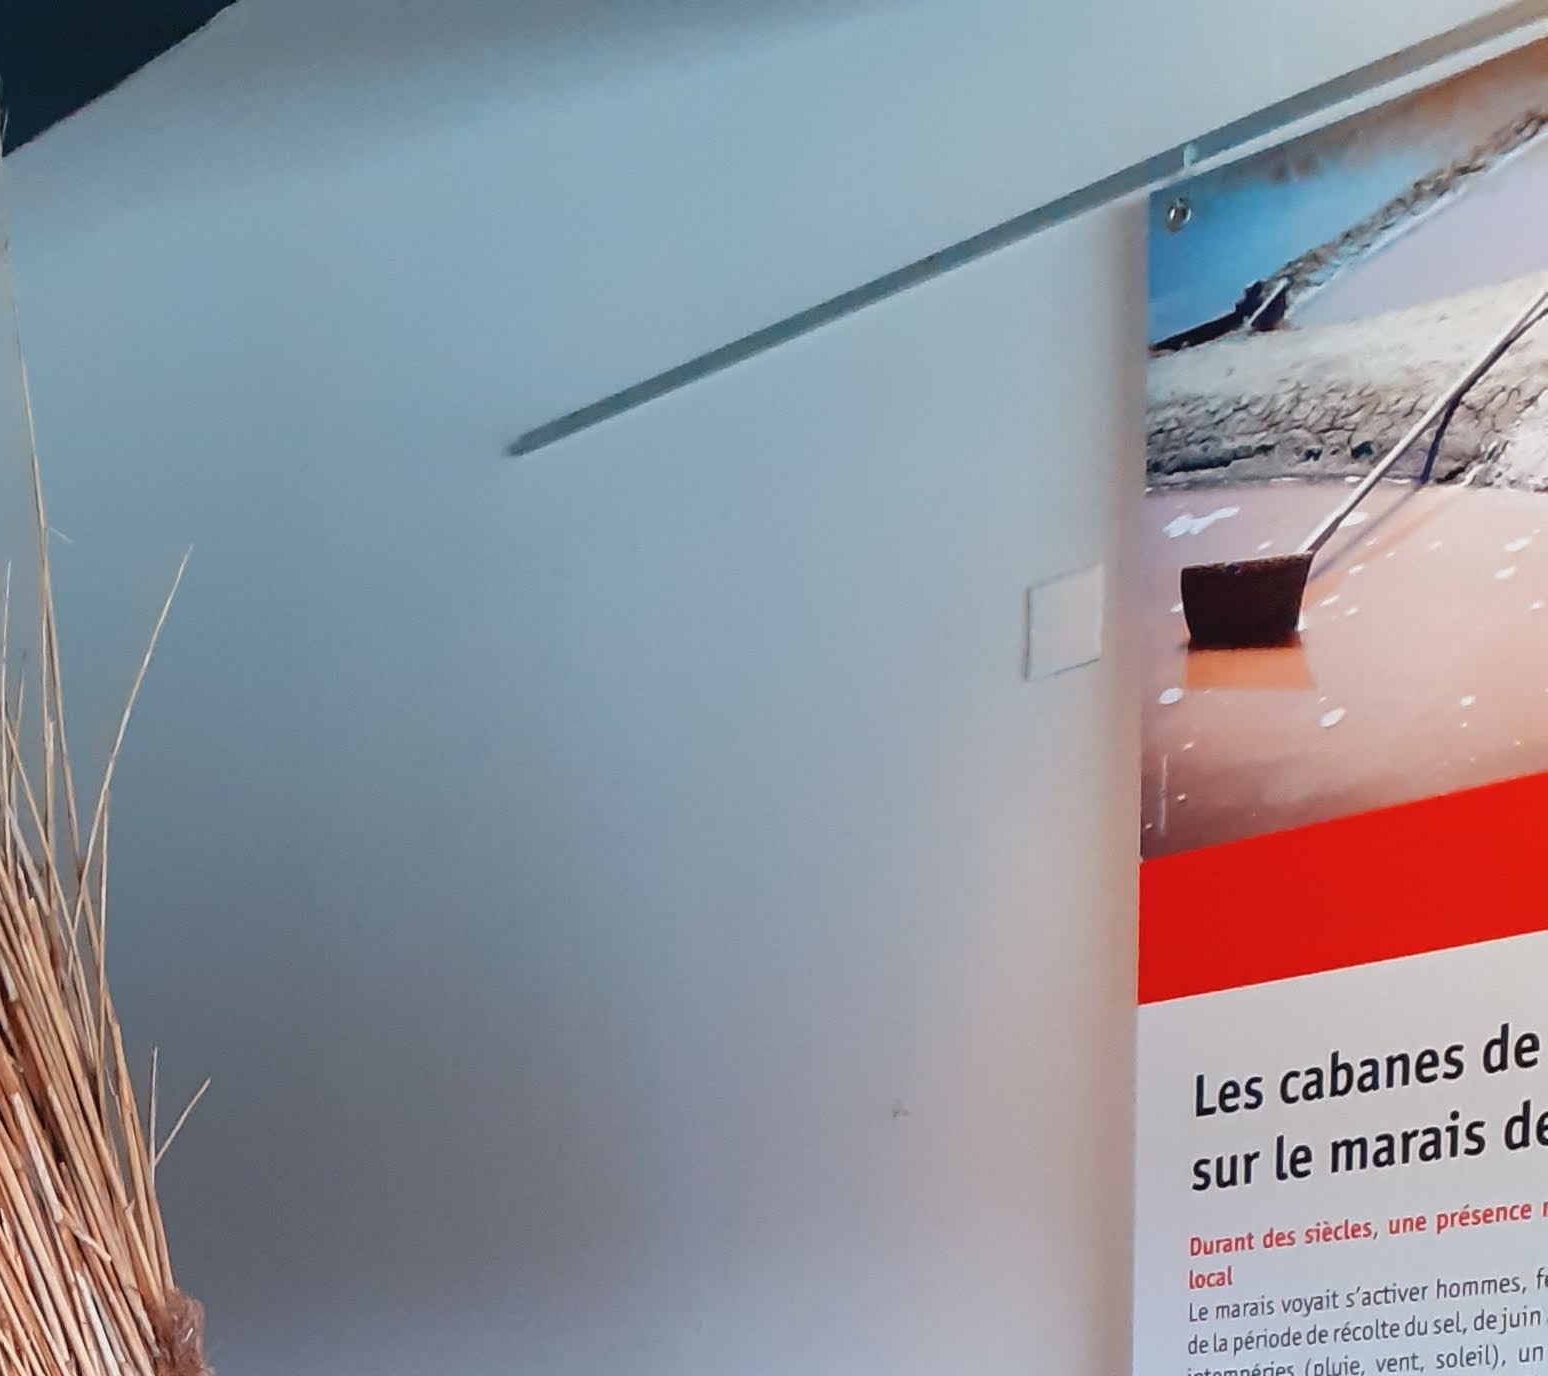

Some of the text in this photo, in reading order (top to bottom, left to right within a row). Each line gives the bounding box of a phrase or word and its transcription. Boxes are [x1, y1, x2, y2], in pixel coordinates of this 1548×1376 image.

[1195, 1022, 1540, 1118] Les cabanes de
[1191, 1151, 1261, 1192] sur
[1275, 1134, 1313, 1181] le
[1331, 1110, 1486, 1174] marais
[1190, 1232, 1255, 1257] Durant
[1262, 1227, 1296, 1249] des
[1304, 1218, 1378, 1245] siècles,
[1388, 1215, 1427, 1235] une
[1436, 1203, 1533, 1235] présence
[1189, 1265, 1233, 1290] local
[1189, 1302, 1209, 1323] Le
[1215, 1295, 1275, 1320] marais
[1281, 1288, 1340, 1318] voyait
[1436, 1276, 1527, 1300] hommes,
[1187, 1305, 1542, 1357] de la période de récolte du sel, de juin
[1375, 1352, 1425, 1373] vent,
[1435, 1344, 1506, 1370] soleil),
[1518, 1345, 1544, 1363] un
